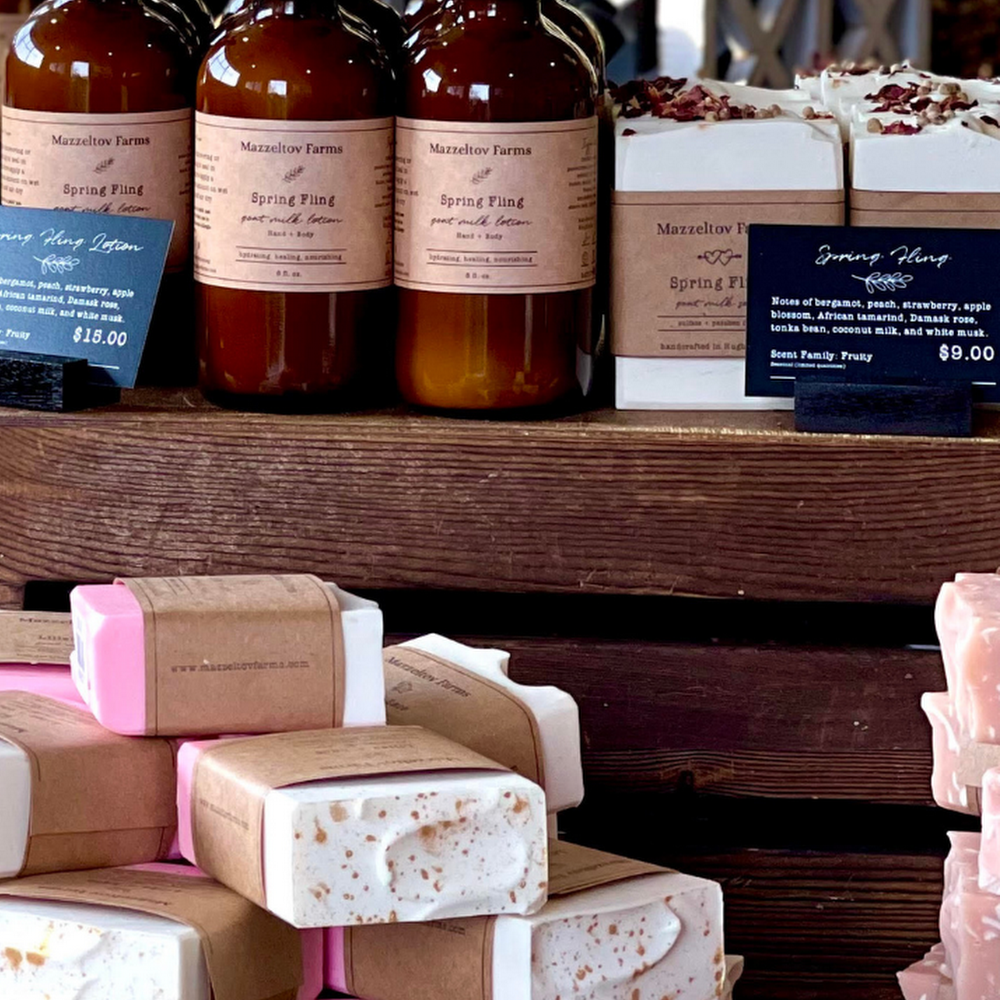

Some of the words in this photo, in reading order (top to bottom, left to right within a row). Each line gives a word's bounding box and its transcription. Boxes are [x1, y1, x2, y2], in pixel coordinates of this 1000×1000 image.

[52, 134, 112, 147] Mazzeltov
[116, 135, 150, 145] Farms
[241, 141, 302, 154] Mazzeltov
[306, 143, 343, 154] Farms
[430, 143, 490, 156] Mazzeltov
[493, 145, 532, 156] Farms
[63, 184, 106, 197] Spring
[111, 184, 144, 196] Fling
[251, 192, 295, 207] Spring
[300, 193, 335, 207] Fling
[441, 194, 484, 209] Spring
[488, 196, 525, 209] Fling
[82, 202, 113, 214] milk
[117, 202, 152, 213] lotion
[241, 215, 269, 224] goat
[270, 213, 303, 224] milk
[307, 214, 343, 224] lotion
[430, 217, 457, 226] goat
[458, 215, 491, 227] milk
[495, 215, 533, 226] lotion
[657, 222, 732, 235] Mazzeltov
[39, 228, 87, 251] Fling
[89, 233, 144, 254] Lotion
[494, 256, 532, 264] nourishing
[815, 244, 884, 266] Spring
[890, 245, 952, 268] Fling
[38, 281, 62, 291] peach,
[65, 282, 111, 296] strawberry,
[112, 287, 135, 299] apple
[670, 276, 723, 292] Spring
[27, 292, 65, 305] tamarind,
[67, 296, 99, 307] Damask
[101, 301, 120, 311] rose,
[675, 299, 703, 309] goat
[704, 296, 733, 308] milk
[771, 297, 799, 306] Notes
[802, 297, 813, 307] of
[815, 298, 864, 309] bergamot,
[867, 300, 899, 310] peach,
[903, 301, 961, 311] strawberry,
[964, 302, 991, 311] apple
[6, 304, 36, 314] coconut
[38, 306, 57, 317] milk,
[60, 309, 75, 318] and
[77, 311, 99, 320] white
[101, 314, 125, 324] musk.
[771, 310, 814, 320] blossom,
[817, 311, 854, 321] African
[857, 312, 907, 324] tamarind,
[910, 314, 950, 323] Damask
[953, 316, 978, 325] rose,
[5, 328, 30, 341] Fruity
[73, 326, 128, 347] $15.00
[770, 323, 800, 333] tonka
[802, 323, 829, 334] bean,
[832, 326, 872, 335] coconut
[875, 326, 901, 336] milk,
[904, 327, 922, 337] and
[926, 328, 954, 337] white
[957, 329, 989, 338] musk.
[770, 349, 797, 359] Scent
[801, 351, 839, 362] Family:
[841, 352, 873, 362] Fruity
[939, 343, 995, 362] $9.00
